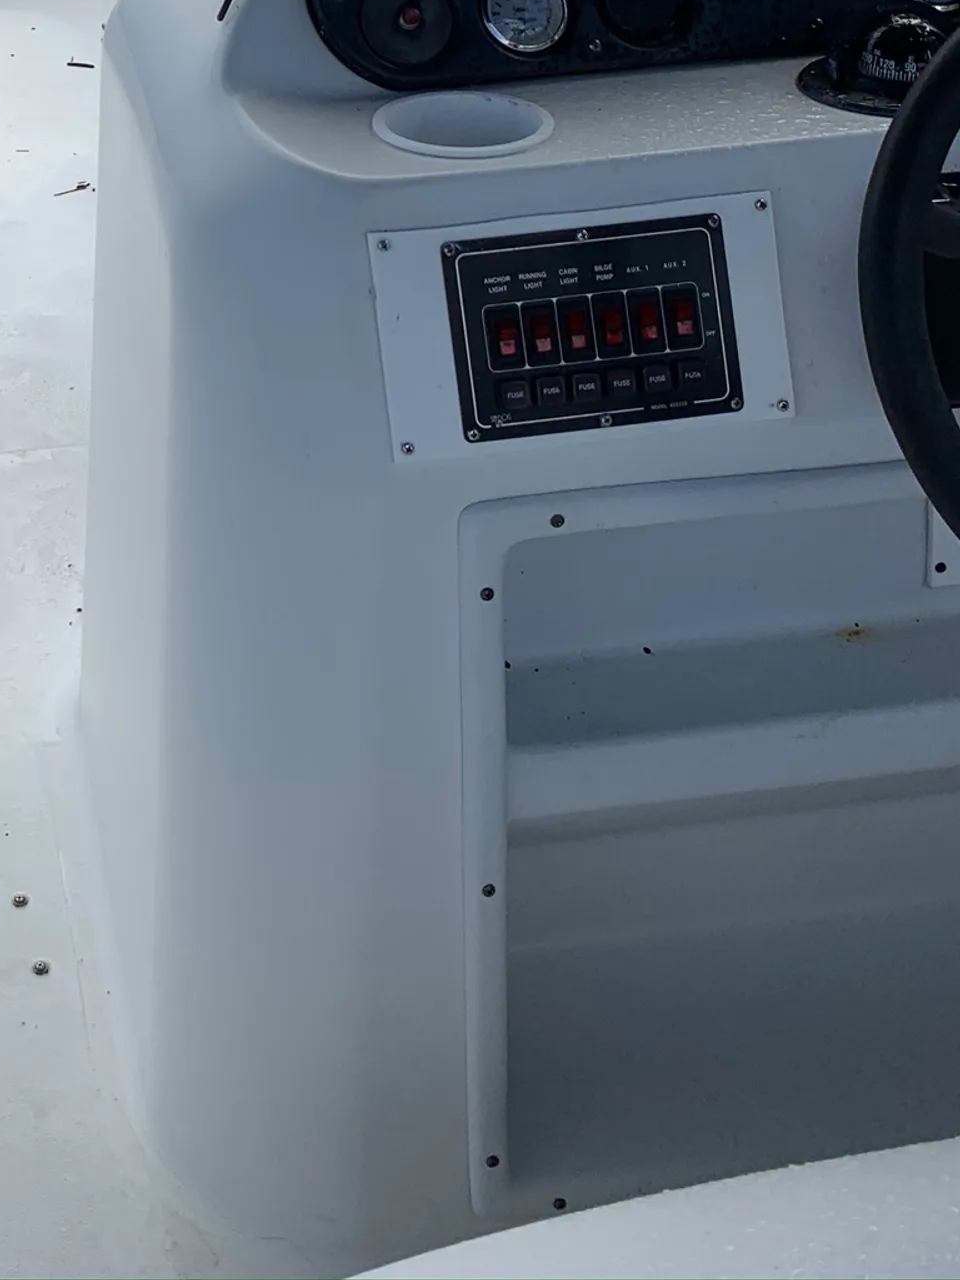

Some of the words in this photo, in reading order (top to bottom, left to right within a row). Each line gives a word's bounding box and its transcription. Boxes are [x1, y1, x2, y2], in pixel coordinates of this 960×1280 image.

[879, 57, 895, 69] 120
[904, 62, 917, 73] 90
[558, 267, 578, 276] CABIN
[593, 263, 613, 272] BILGE
[483, 275, 511, 285] ANCHOR
[518, 271, 547, 280] RUNNING
[596, 273, 614, 281] PUMP
[559, 276, 578, 285] LIGHT
[488, 285, 508, 294] LIGHT
[523, 281, 543, 290] LIGHT
[578, 382, 595, 391] FUSE
[613, 379, 631, 387] FUSE
[507, 391, 524, 399] FUSE
